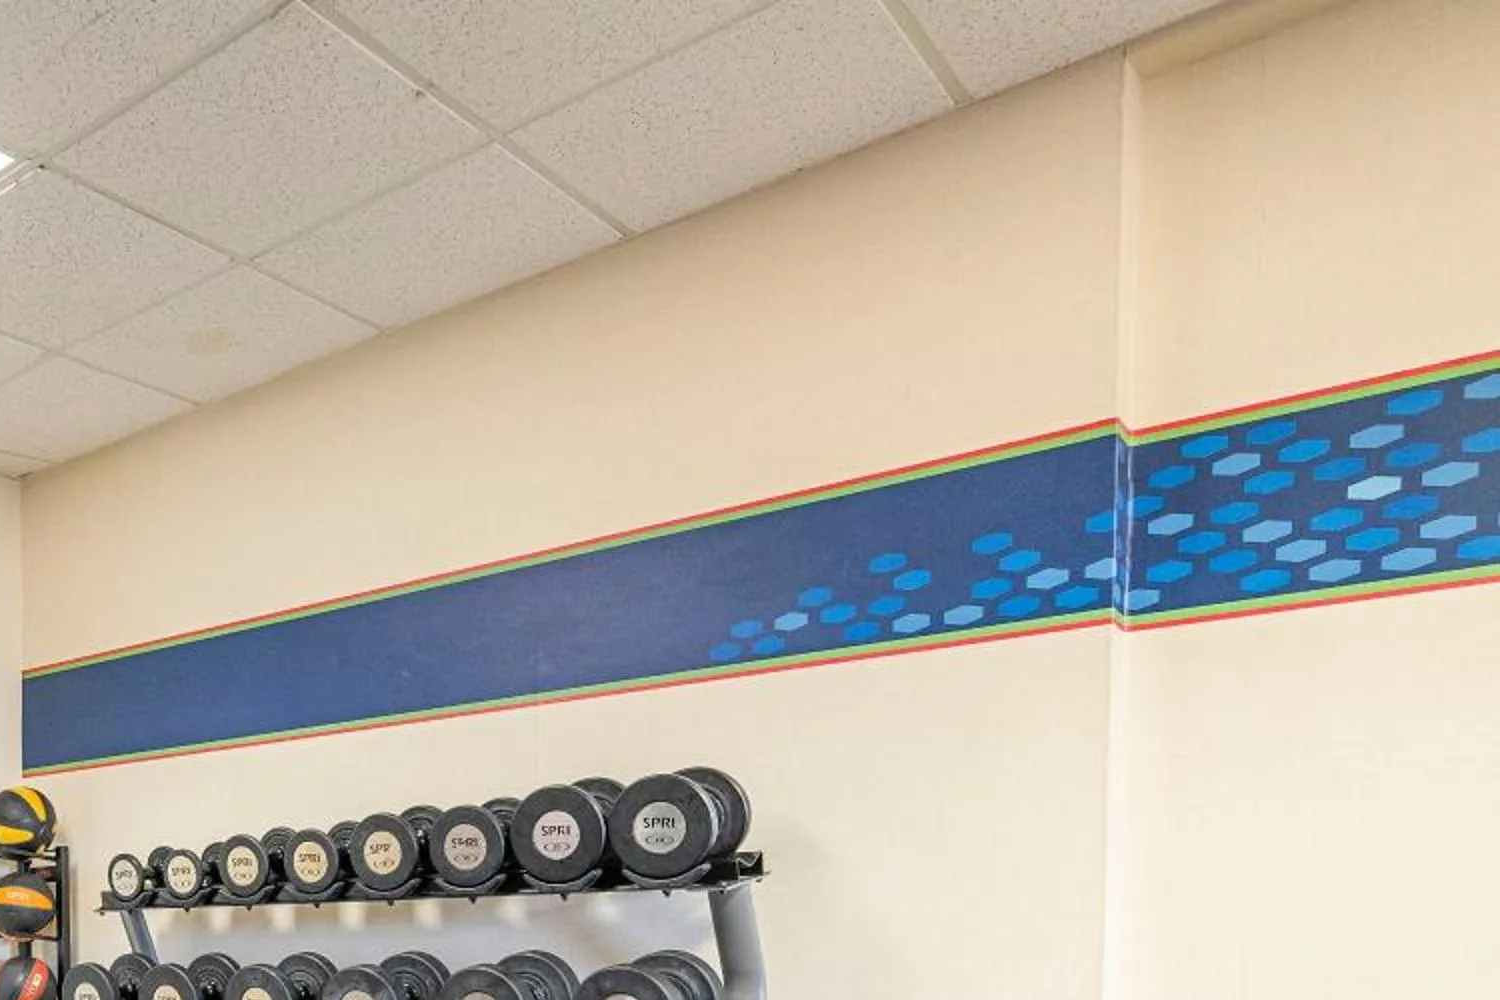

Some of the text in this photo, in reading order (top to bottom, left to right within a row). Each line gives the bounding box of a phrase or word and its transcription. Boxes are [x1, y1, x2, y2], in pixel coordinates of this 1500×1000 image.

[643, 816, 676, 829] SPRI
[541, 824, 572, 837] SPRI
[231, 856, 254, 868] SPRI
[299, 852, 322, 863] SPRI
